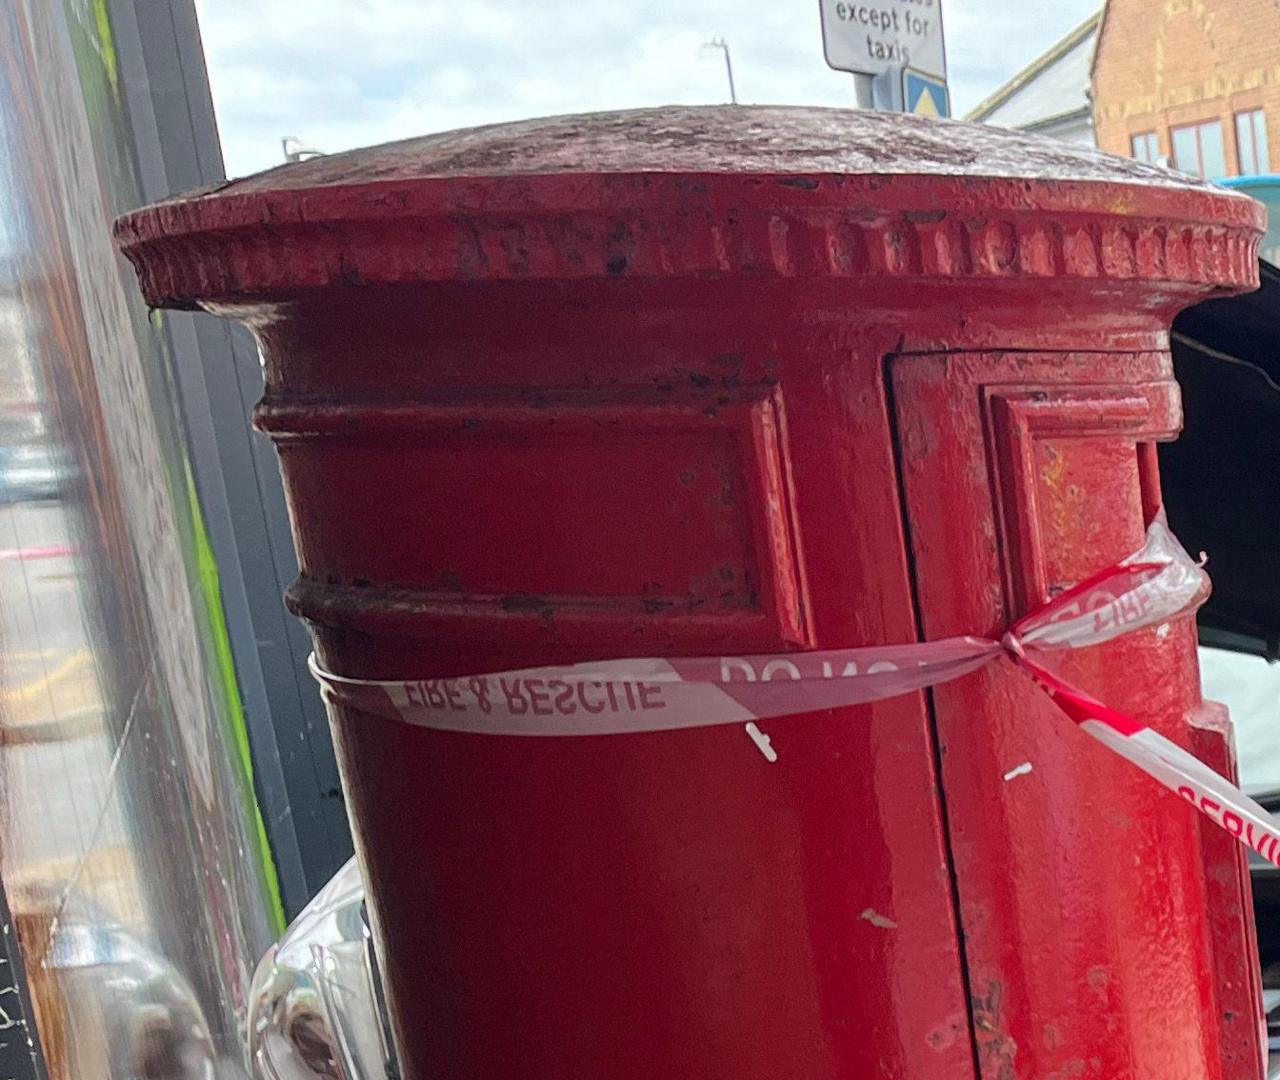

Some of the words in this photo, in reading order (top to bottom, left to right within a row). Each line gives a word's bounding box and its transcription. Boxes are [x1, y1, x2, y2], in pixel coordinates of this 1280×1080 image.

[836, 2, 899, 34] except
[905, 10, 928, 37] for
[866, 33, 910, 64] taxis
